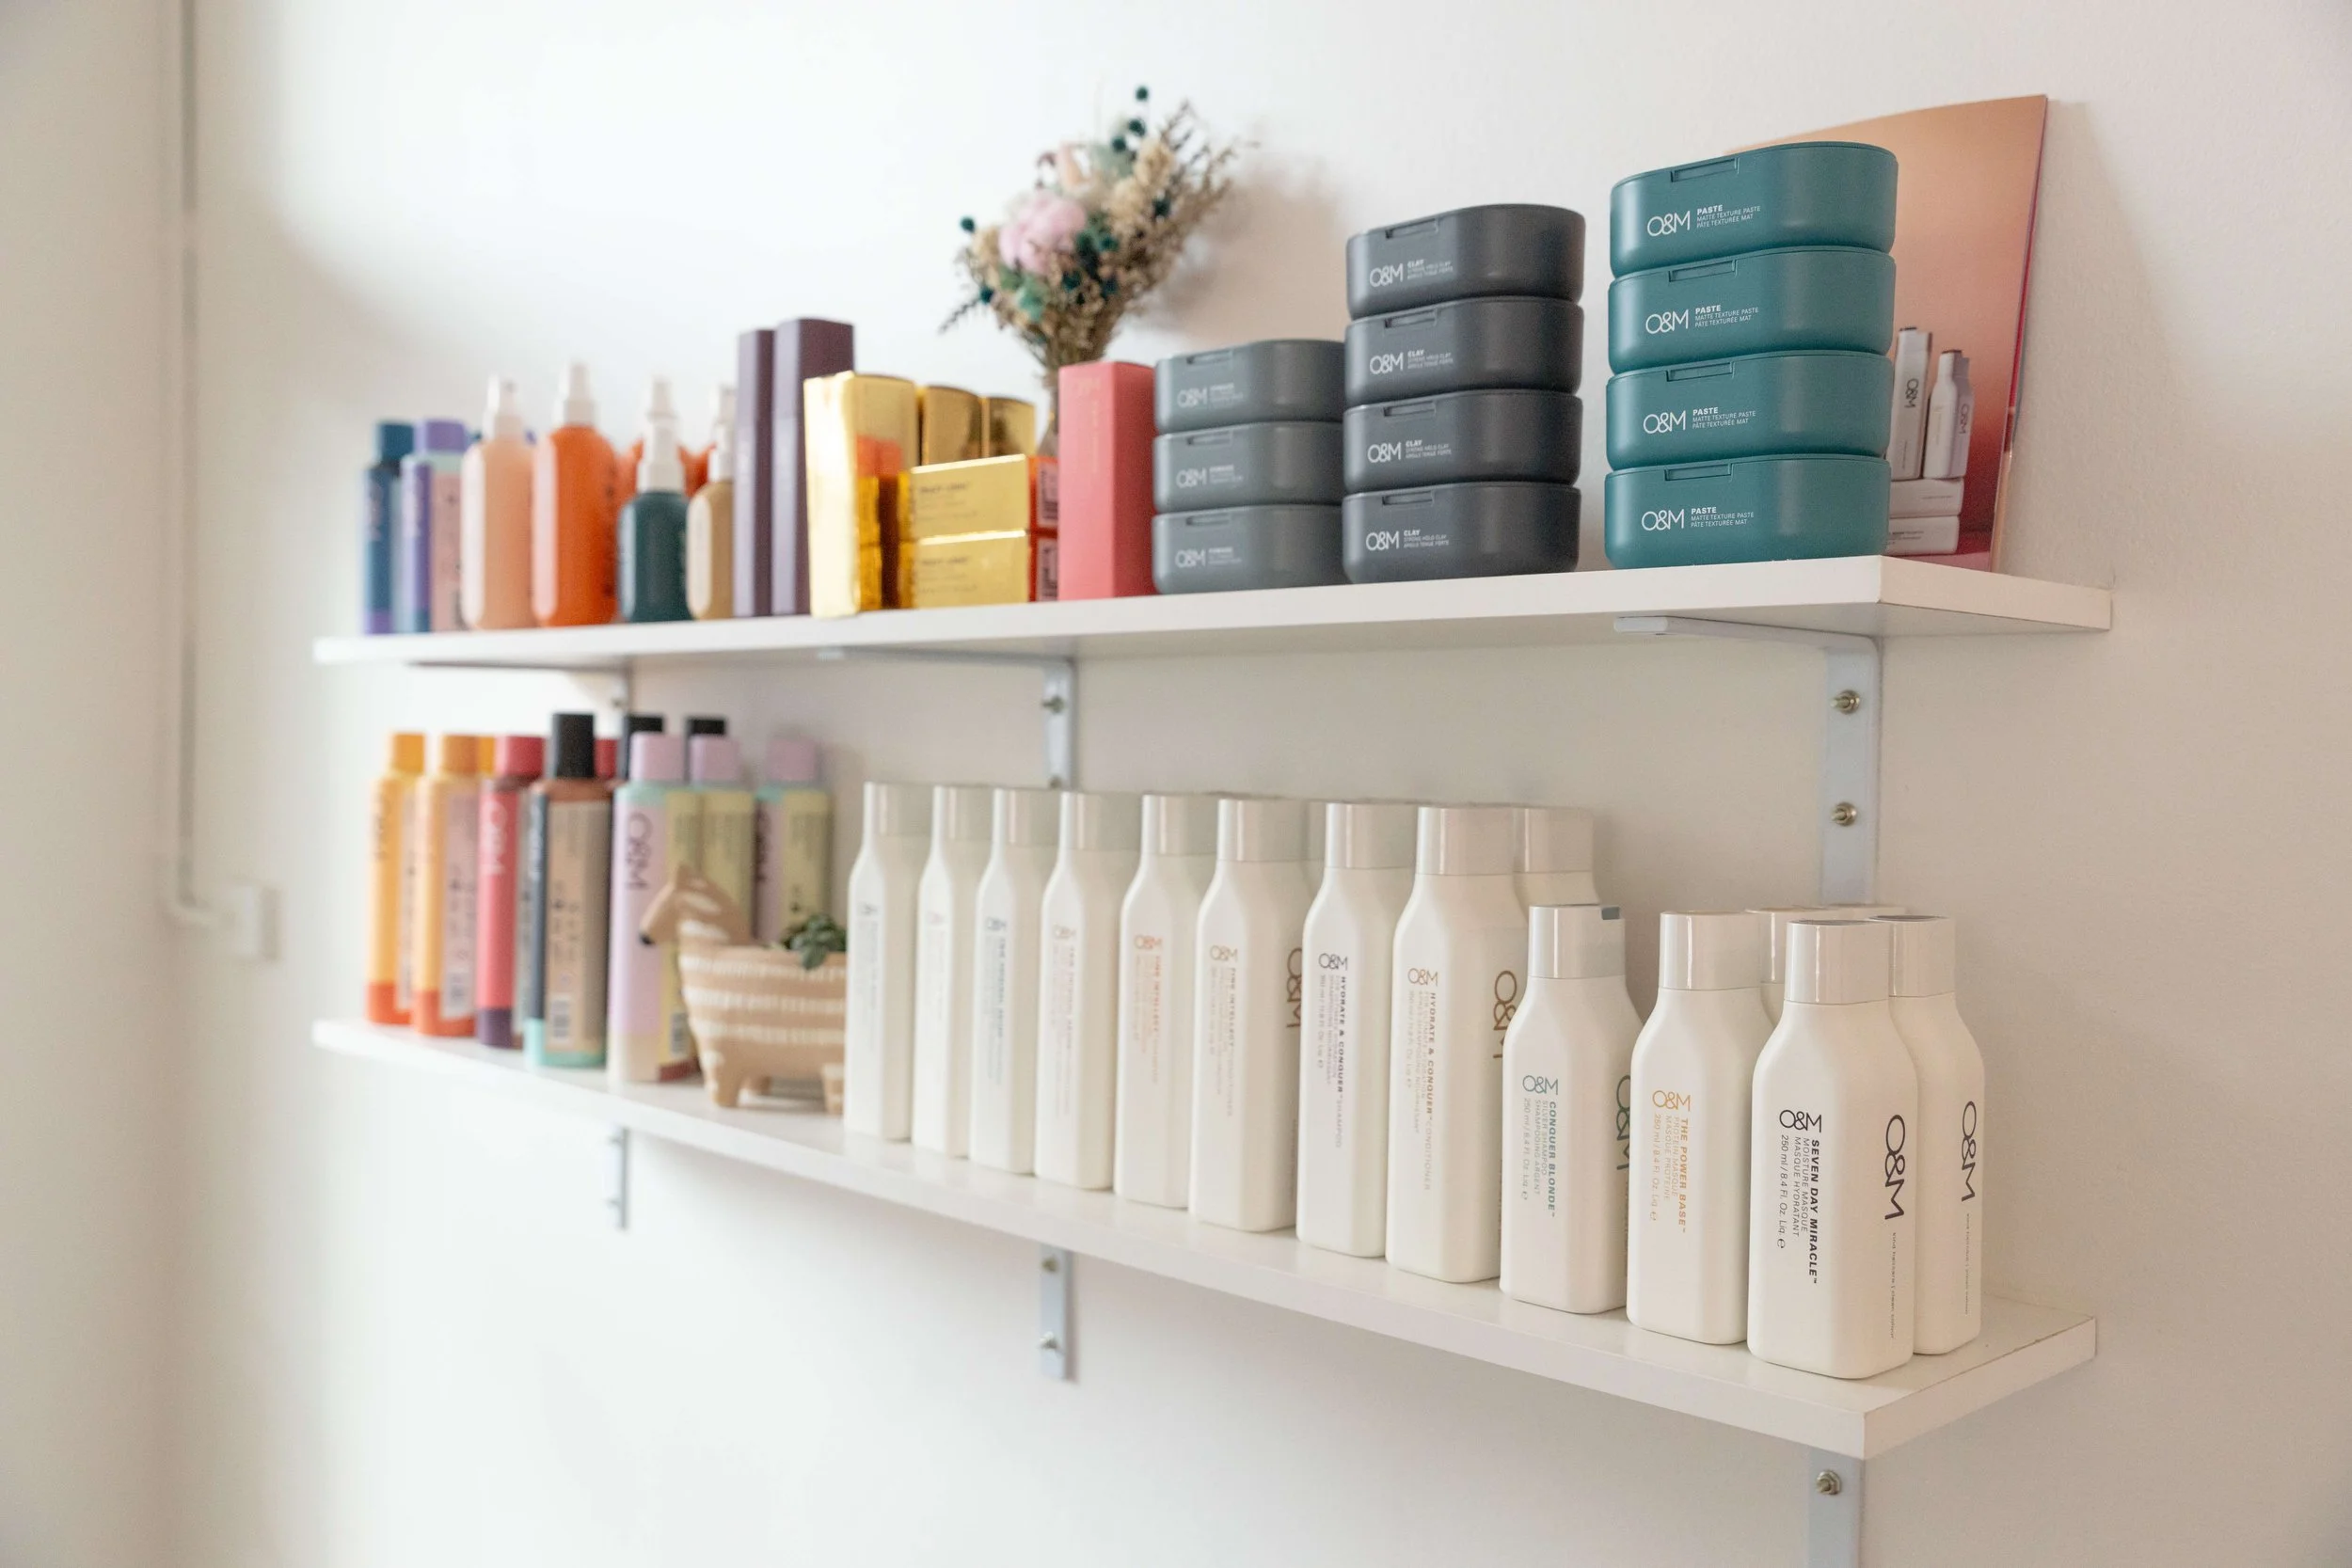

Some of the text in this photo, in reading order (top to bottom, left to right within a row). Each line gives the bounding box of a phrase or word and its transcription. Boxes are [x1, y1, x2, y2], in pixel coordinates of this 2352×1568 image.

[1697, 205, 1723, 215] PASTE
[1647, 210, 1691, 236] O&M
[1370, 263, 1403, 287] O&M
[1695, 304, 1721, 314] PASTE
[1646, 309, 1689, 334] O&M
[1370, 352, 1403, 374] O&M
[1643, 410, 1686, 434] O&M
[1693, 407, 1719, 416] PASTE
[1367, 442, 1401, 463] O&M
[1641, 508, 1685, 531] O&M
[1691, 507, 1716, 515] PASTE
[1366, 531, 1399, 551] O&M
[1319, 953, 1348, 971] O&M
[1408, 968, 1438, 987] O&M
[1522, 1075, 1558, 1095] O&M
[1653, 1091, 1690, 1112] O&M
[1780, 1110, 1821, 1133] O&M
[1781, 1154, 1788, 1166] ml
[1811, 1139, 1819, 1182] SEVEN
[1962, 1101, 1977, 1201] O&M
[1801, 1138, 1810, 1187] MOISTURE
[1885, 1115, 1905, 1220] O&M
